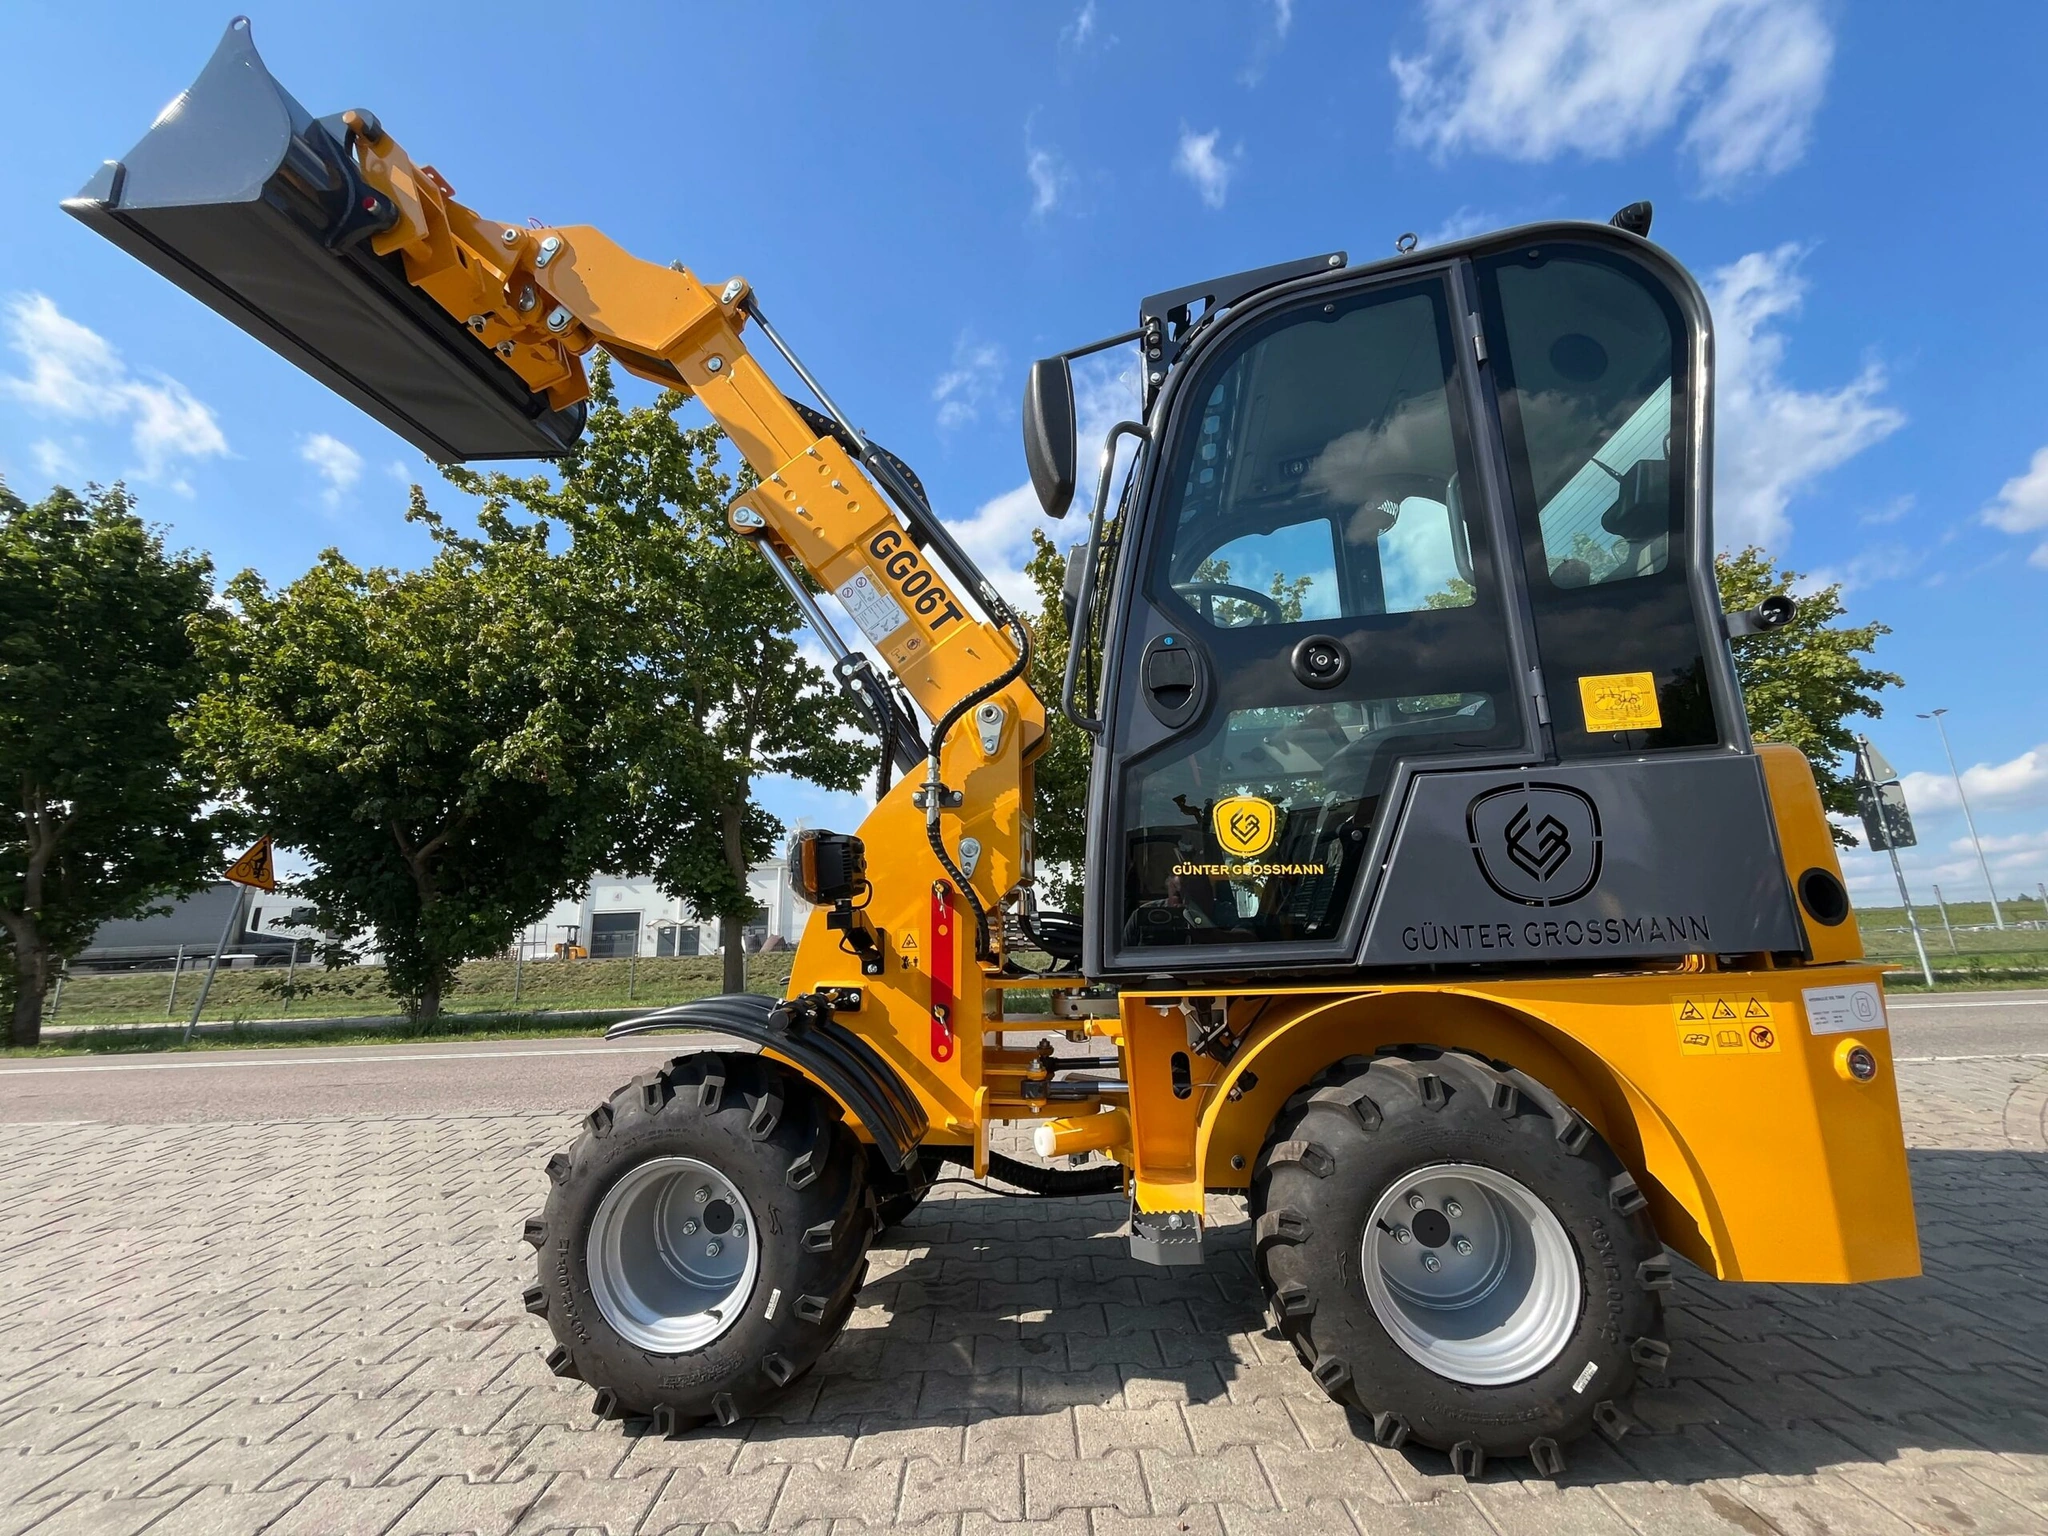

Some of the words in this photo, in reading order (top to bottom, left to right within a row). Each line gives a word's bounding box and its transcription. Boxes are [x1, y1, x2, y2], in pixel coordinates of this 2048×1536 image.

[869, 530, 963, 631] GG06T
[1172, 861, 1229, 875] GÜNTER
[1232, 864, 1324, 875] GROSSMANN
[1402, 921, 1516, 951] GÜNTER
[1524, 915, 1711, 947] GROSSMANN
